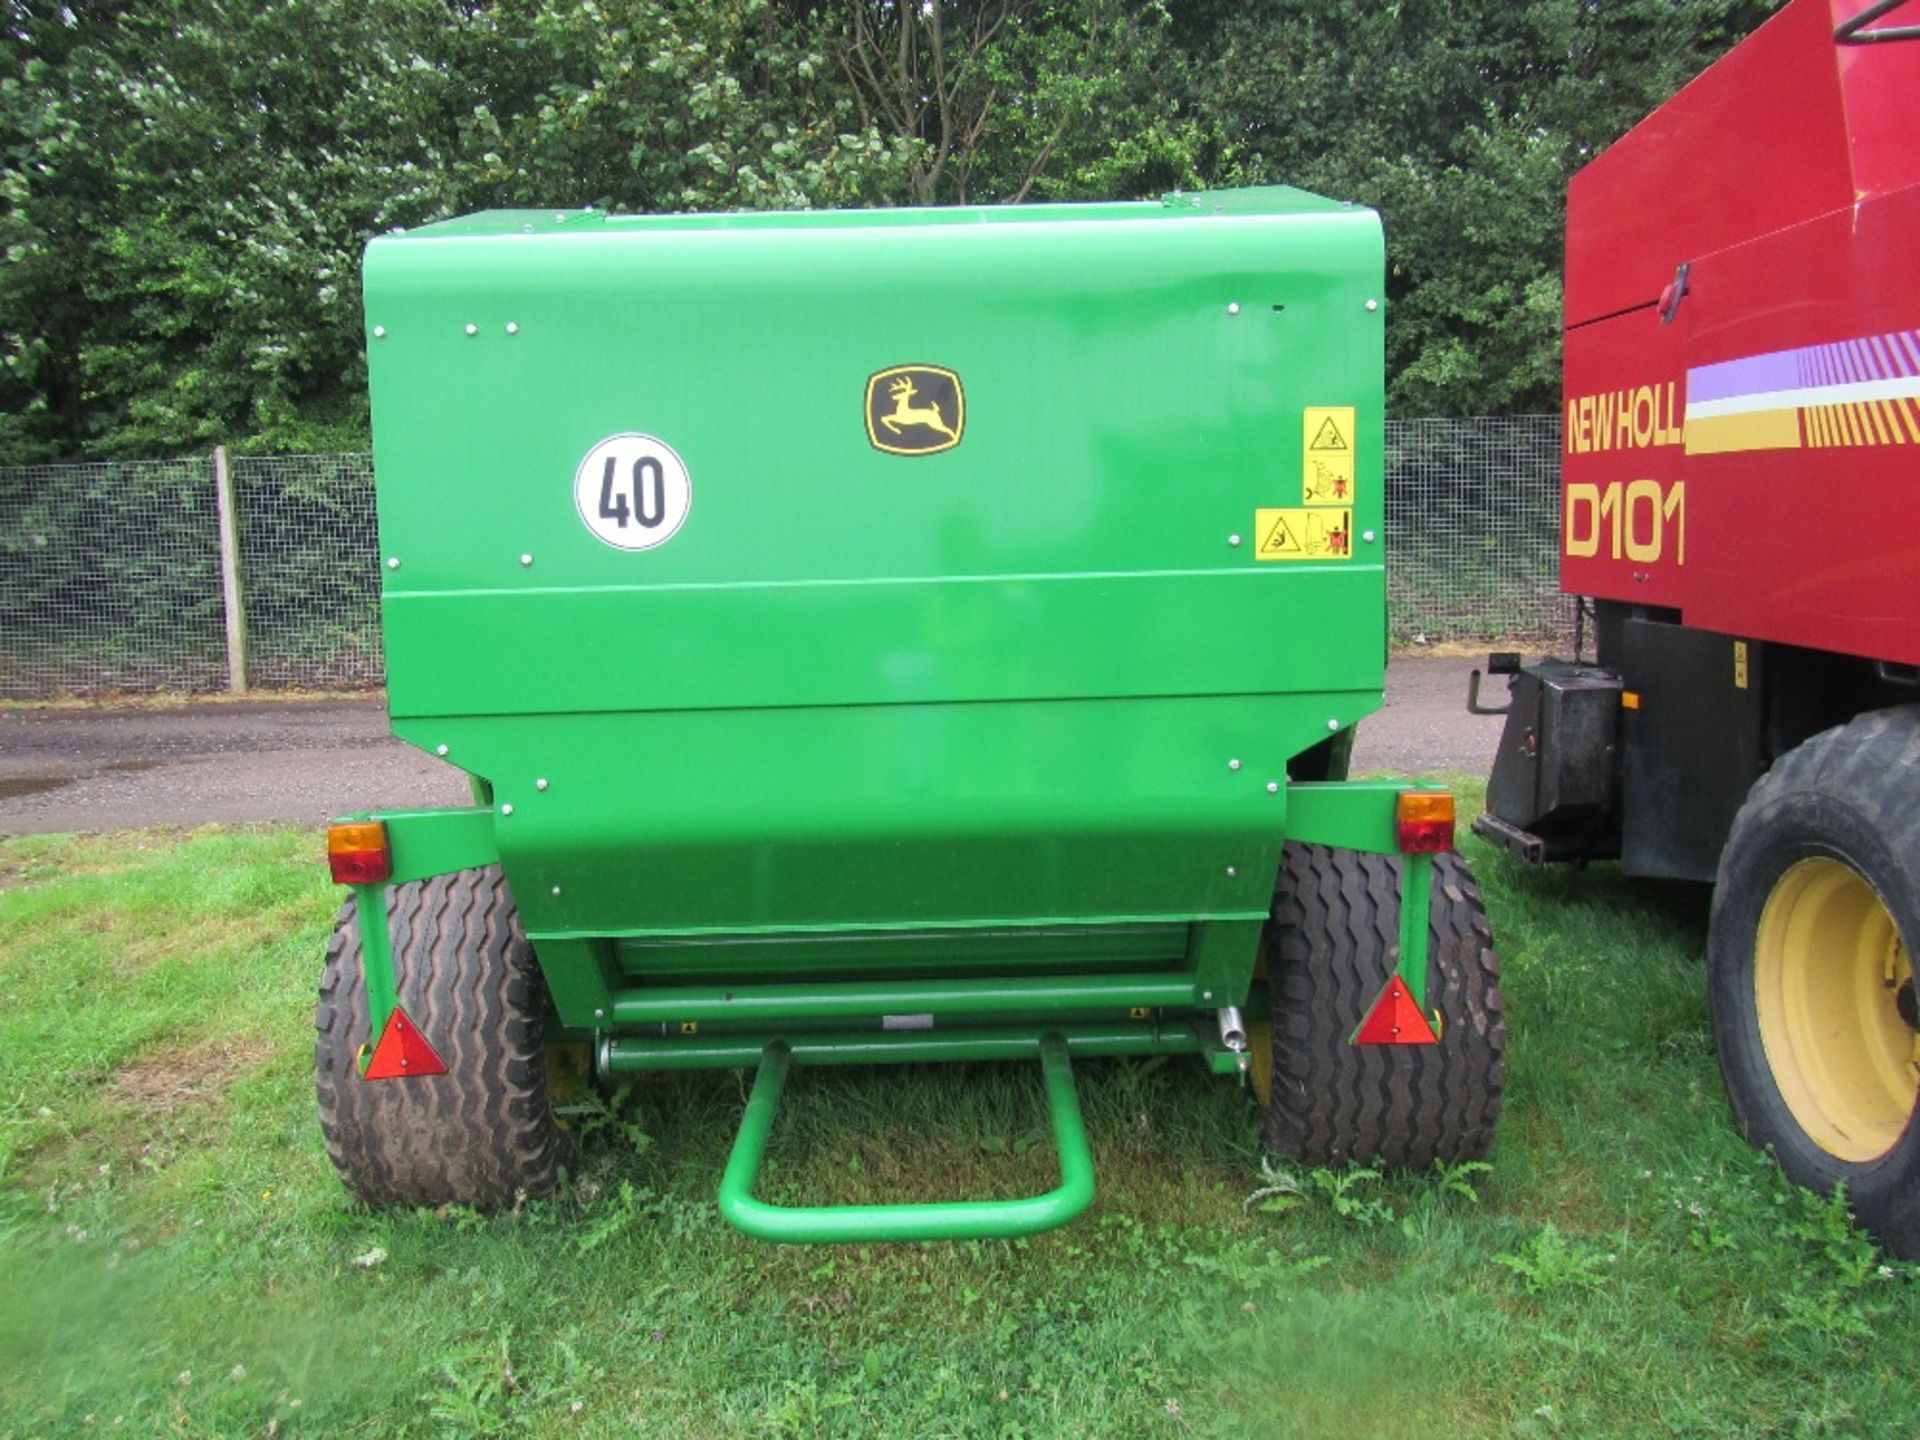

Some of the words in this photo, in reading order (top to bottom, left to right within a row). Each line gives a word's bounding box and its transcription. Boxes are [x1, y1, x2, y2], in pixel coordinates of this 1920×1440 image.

[1568, 392, 1615, 454] NEW
[1616, 381, 1685, 450] HOLL
[599, 455, 665, 528] 40
